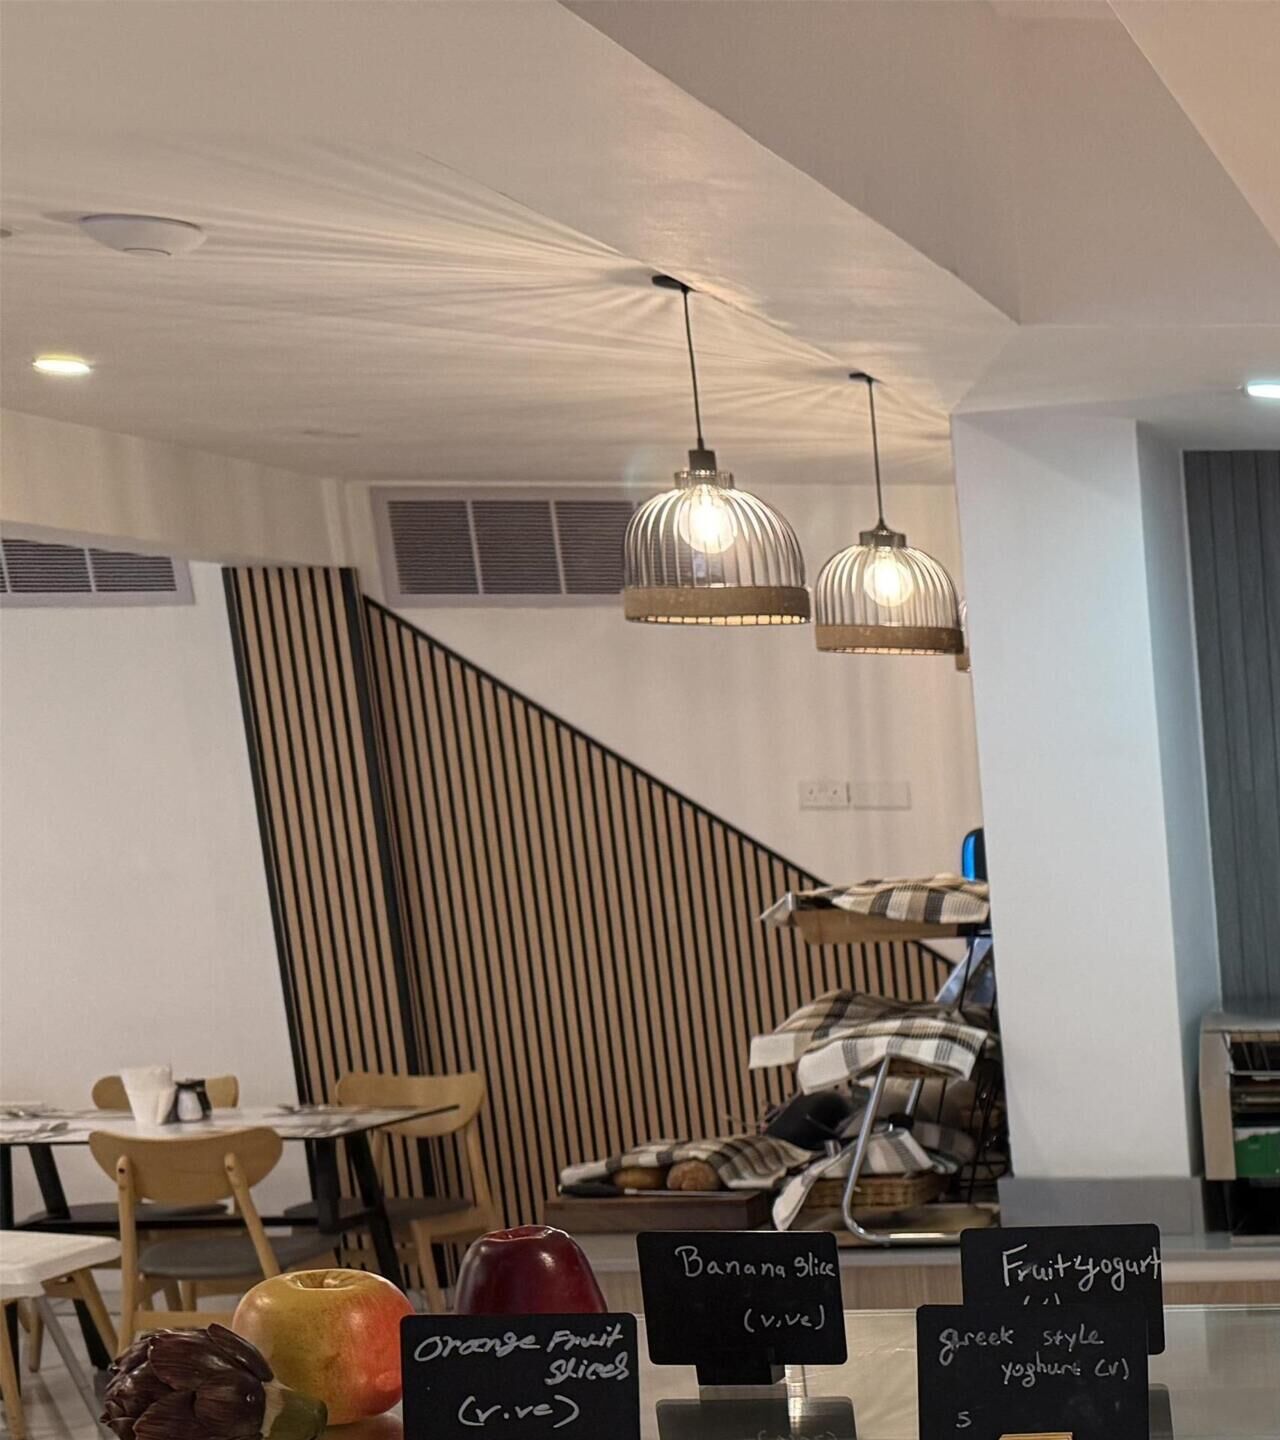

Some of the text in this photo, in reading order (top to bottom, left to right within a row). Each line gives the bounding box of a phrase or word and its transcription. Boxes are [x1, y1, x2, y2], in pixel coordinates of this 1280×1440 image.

[674, 1245, 786, 1278] Banana
[1002, 1243, 1161, 1292] Fruit yogurt
[546, 1323, 623, 1353] Fruit
[939, 1323, 1104, 1366] greek style
[1001, 1351, 1082, 1388] yoghurt
